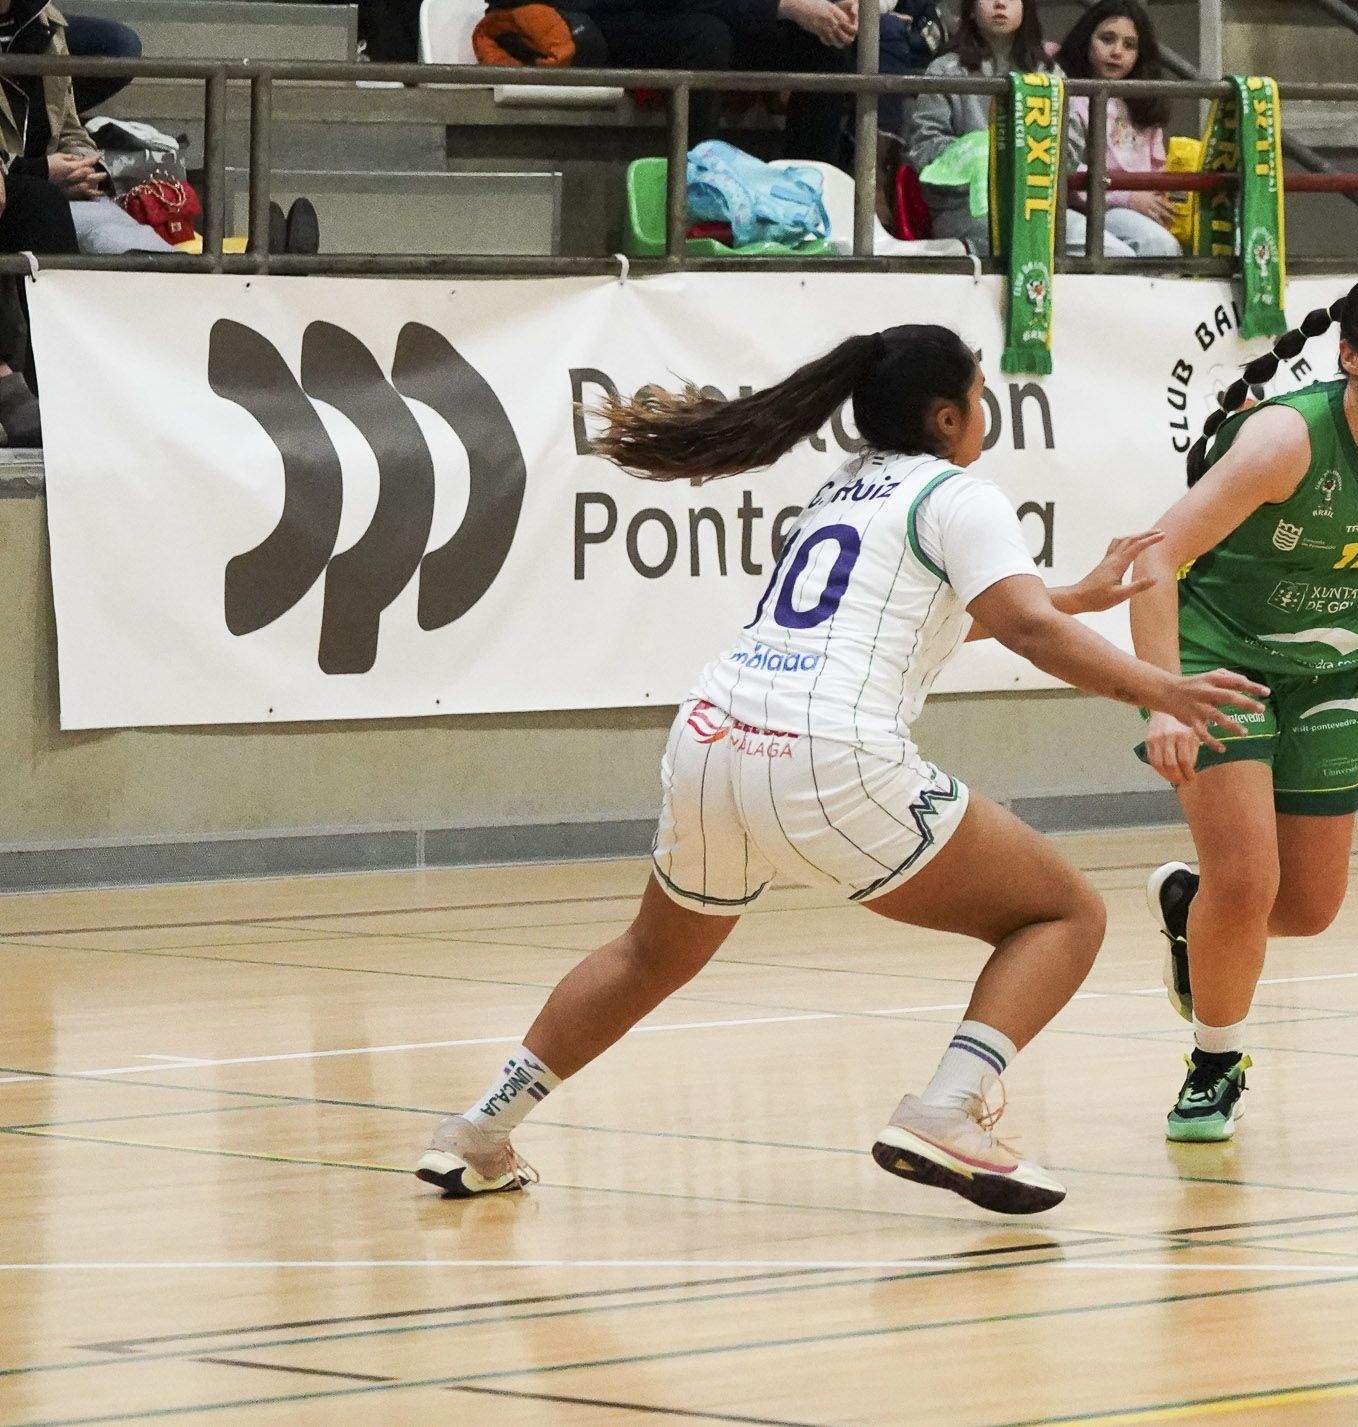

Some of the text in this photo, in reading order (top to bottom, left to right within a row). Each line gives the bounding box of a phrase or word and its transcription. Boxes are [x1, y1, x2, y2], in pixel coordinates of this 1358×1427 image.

[1167, 358, 1194, 453] CLUB
[742, 523, 862, 630] 10
[479, 1066, 534, 1117] UNICAJA
